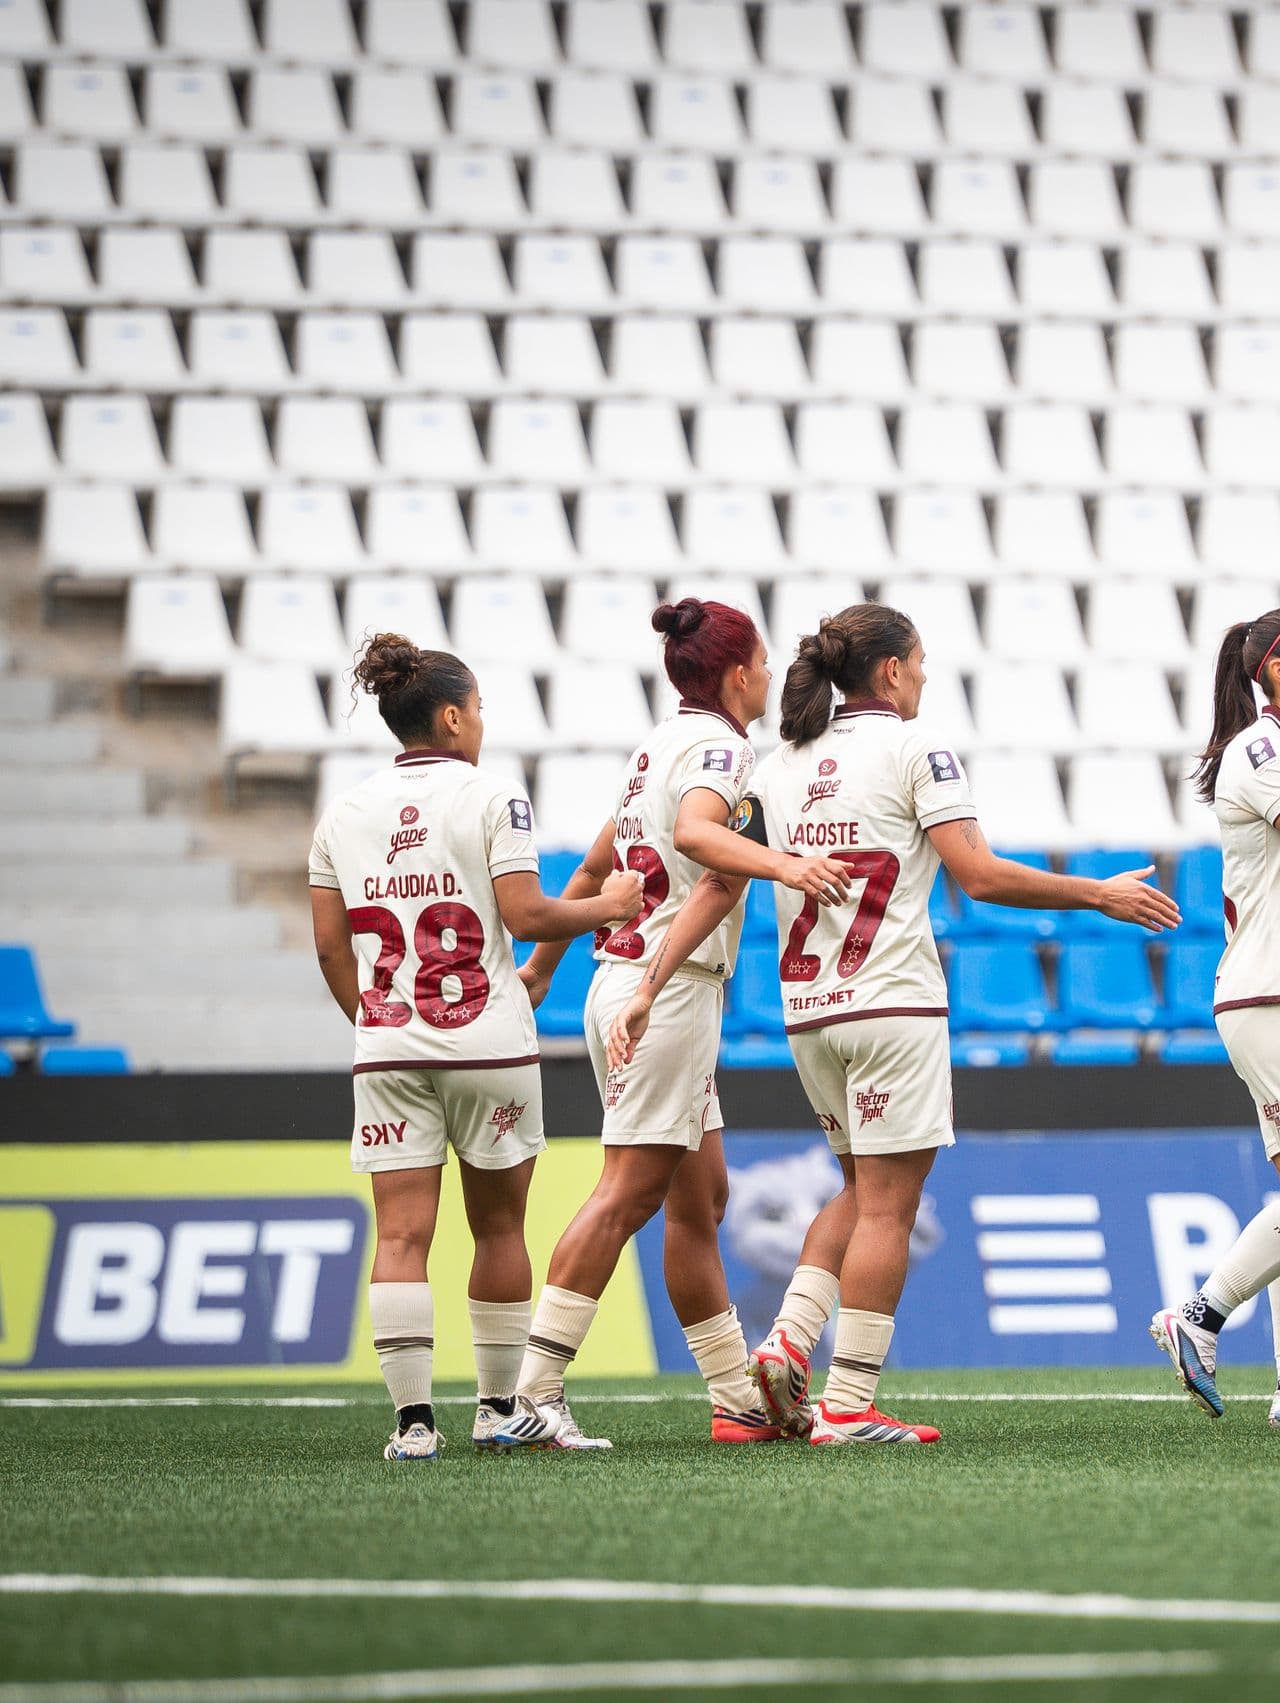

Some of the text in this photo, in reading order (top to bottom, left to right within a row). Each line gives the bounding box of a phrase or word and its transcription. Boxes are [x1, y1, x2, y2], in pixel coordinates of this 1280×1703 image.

[801, 778, 842, 813] yape
[386, 827, 428, 865] yape
[786, 821, 859, 847] LACOSTE
[364, 872, 462, 901] CLAUDIA D.
[779, 850, 901, 983] 27
[345, 901, 490, 1029] 28
[788, 989, 855, 1011] TELETICKET
[856, 1092, 890, 1106] Electro
[862, 1105, 884, 1121] light
[361, 1120, 408, 1147] SKY
[55, 1210, 354, 1346] BET
